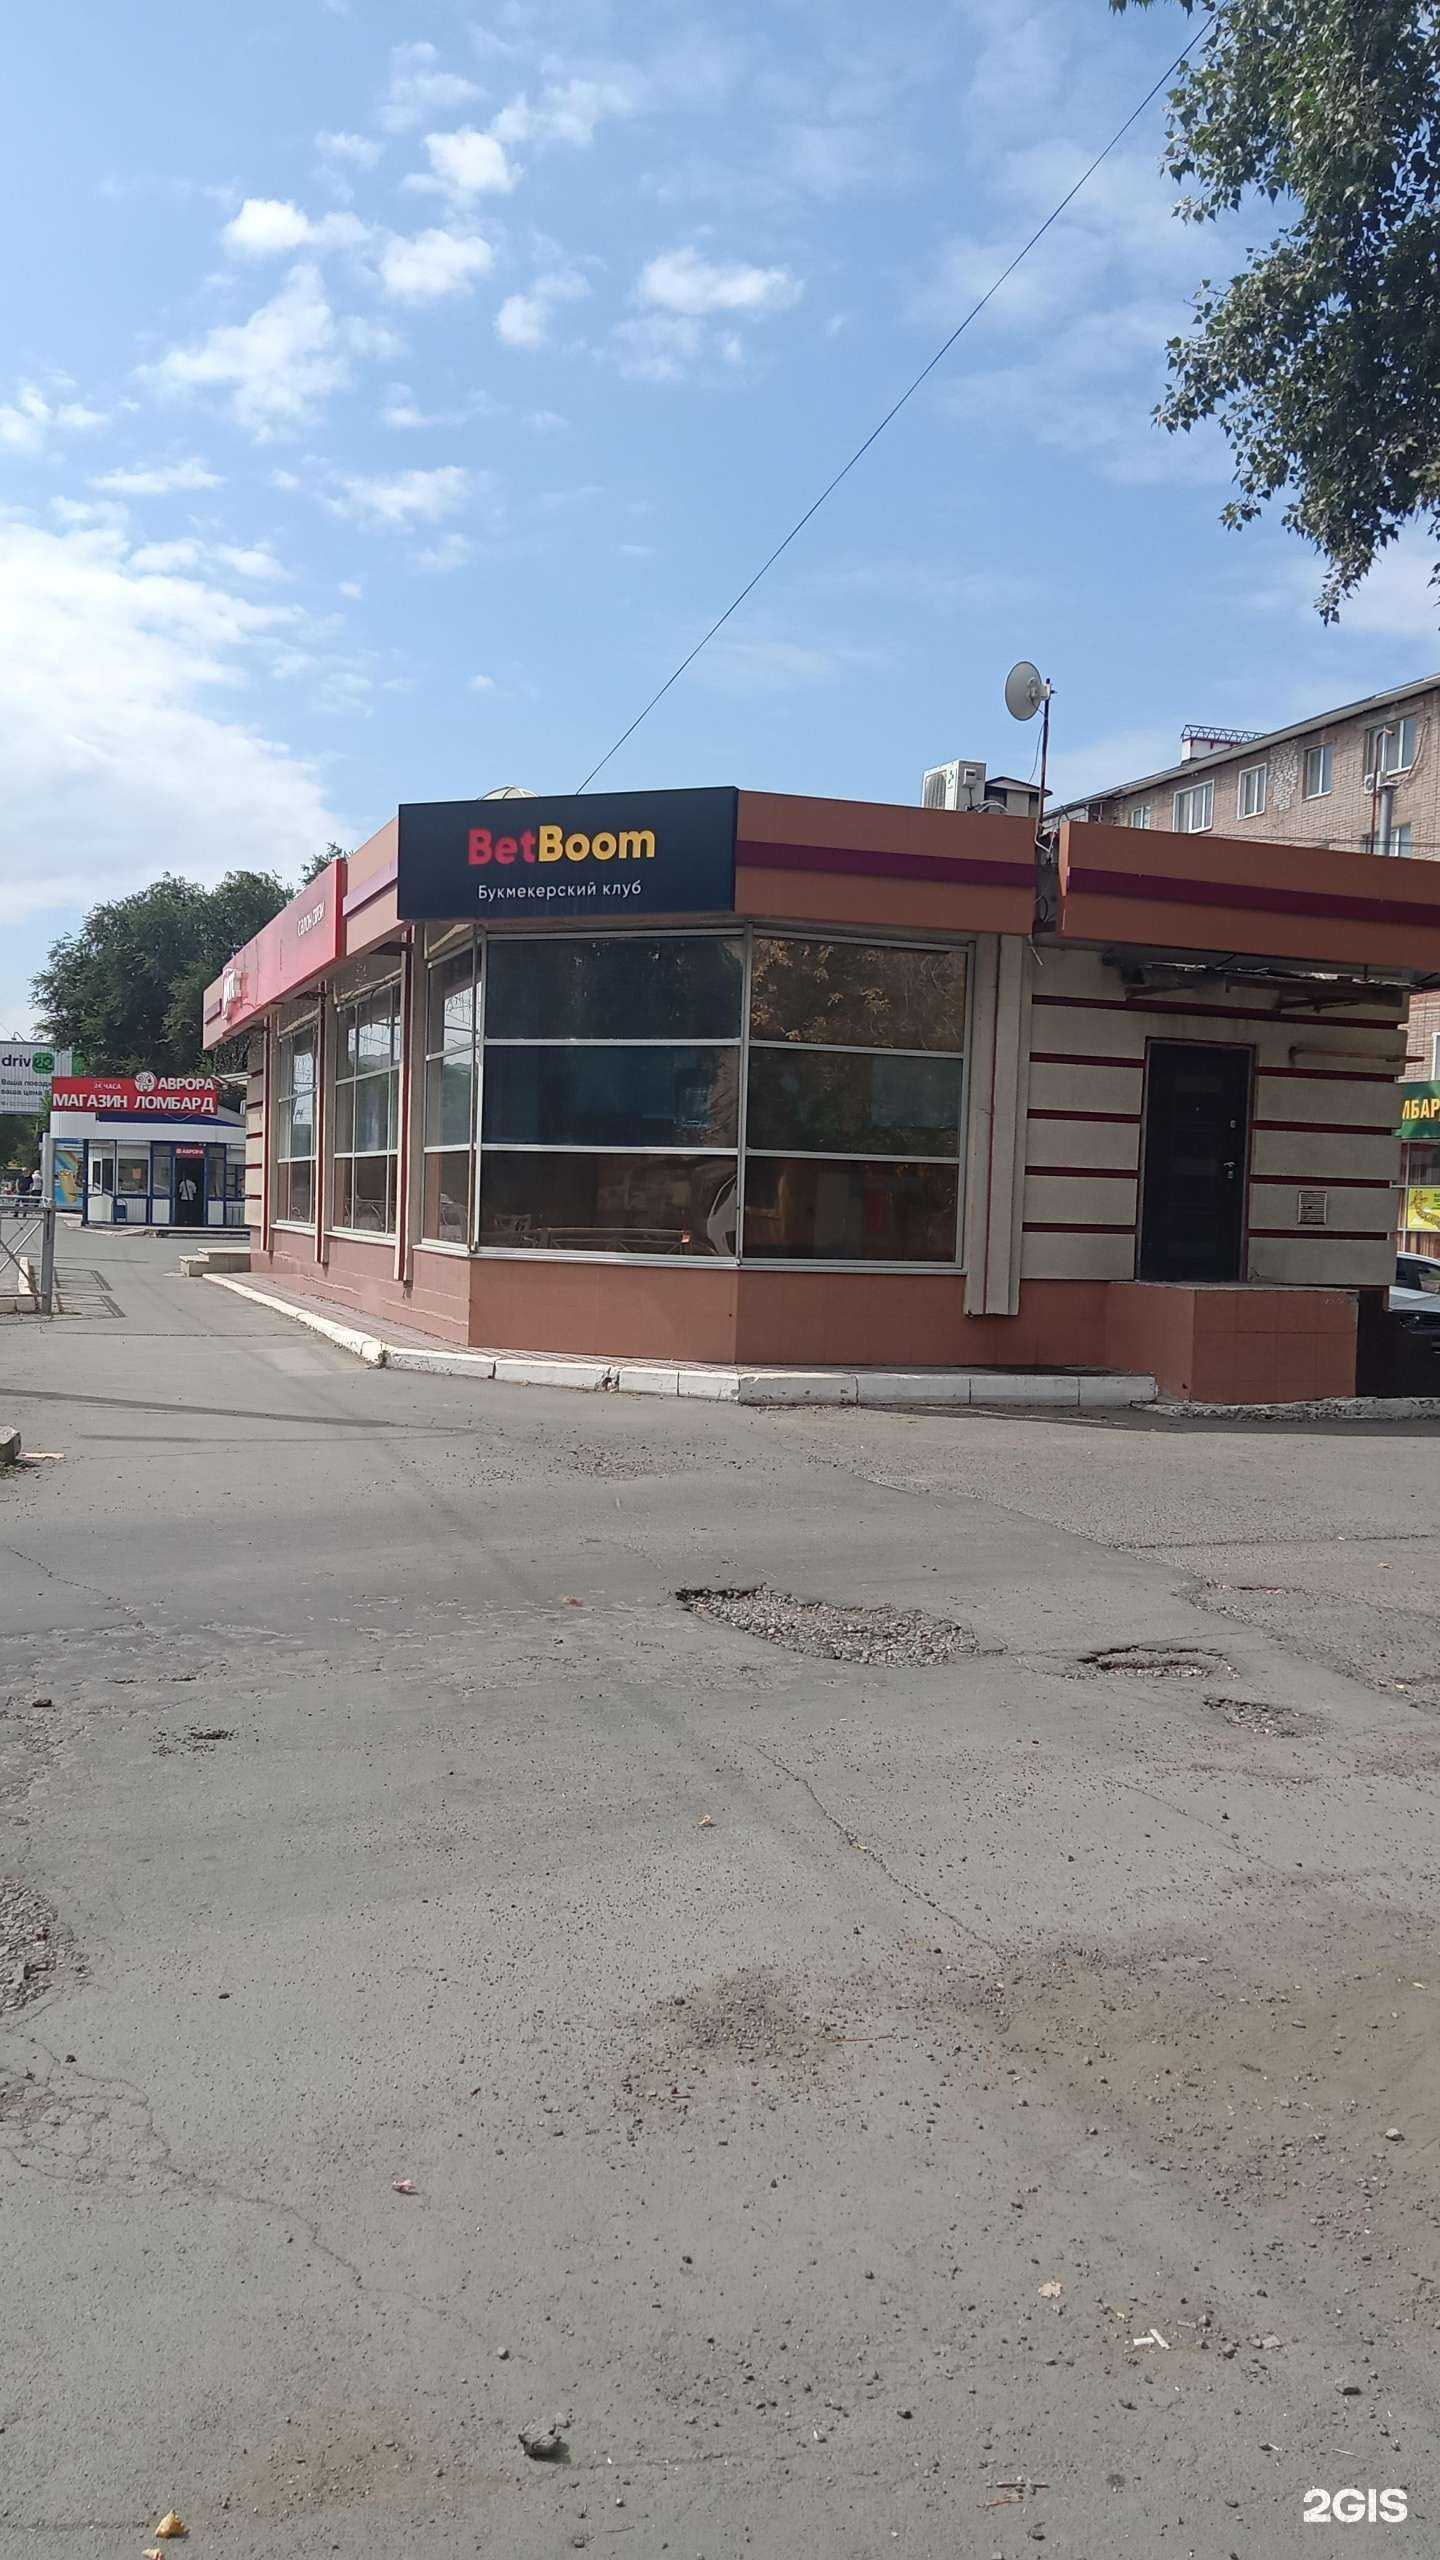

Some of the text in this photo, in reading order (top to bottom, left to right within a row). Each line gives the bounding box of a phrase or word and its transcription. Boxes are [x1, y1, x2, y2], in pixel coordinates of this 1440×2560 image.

[467, 824, 656, 866] BetBoom
[478, 879, 642, 901] Букмекерский клуб
[158, 1077, 215, 1091] АВРОРА
[53, 1093, 214, 1113] МАГАЗИН ЛОМБАРД
